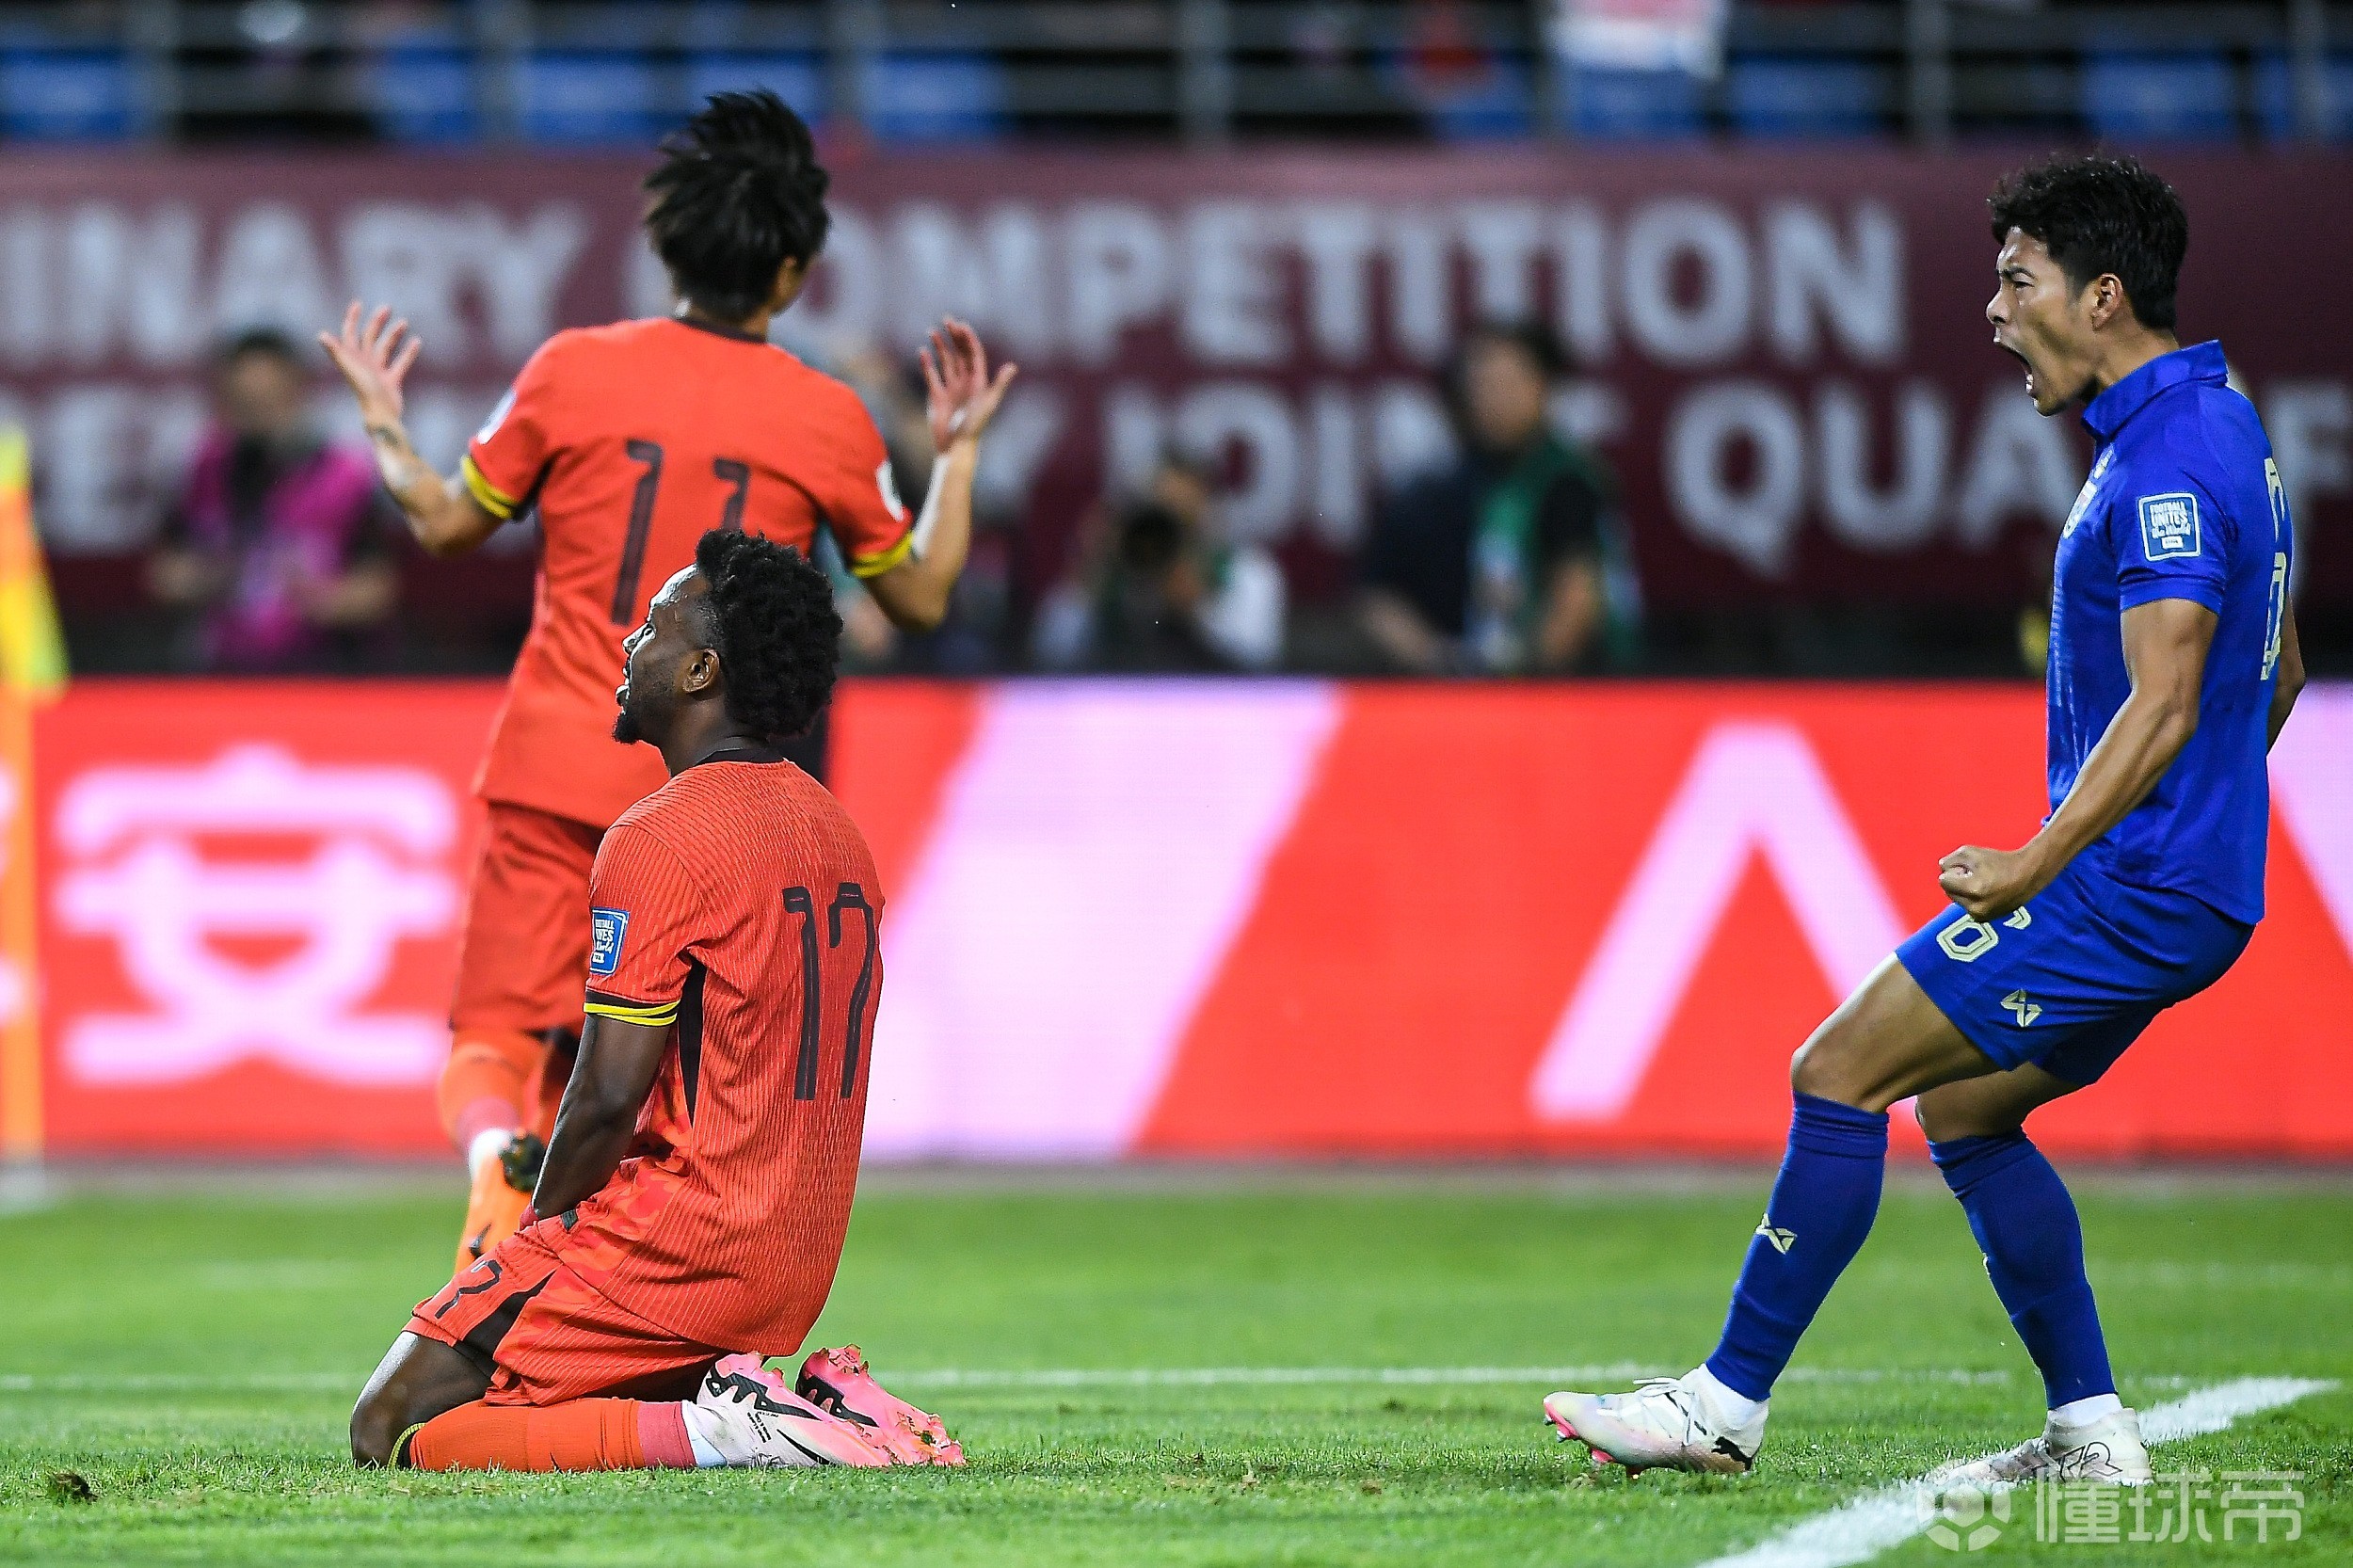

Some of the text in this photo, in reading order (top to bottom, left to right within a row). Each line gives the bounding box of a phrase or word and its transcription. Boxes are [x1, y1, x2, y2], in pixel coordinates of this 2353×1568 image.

[627, 196, 1905, 369] OMPETITION
[56, 745, 461, 1088] 安
[782, 882, 876, 1101] 17
